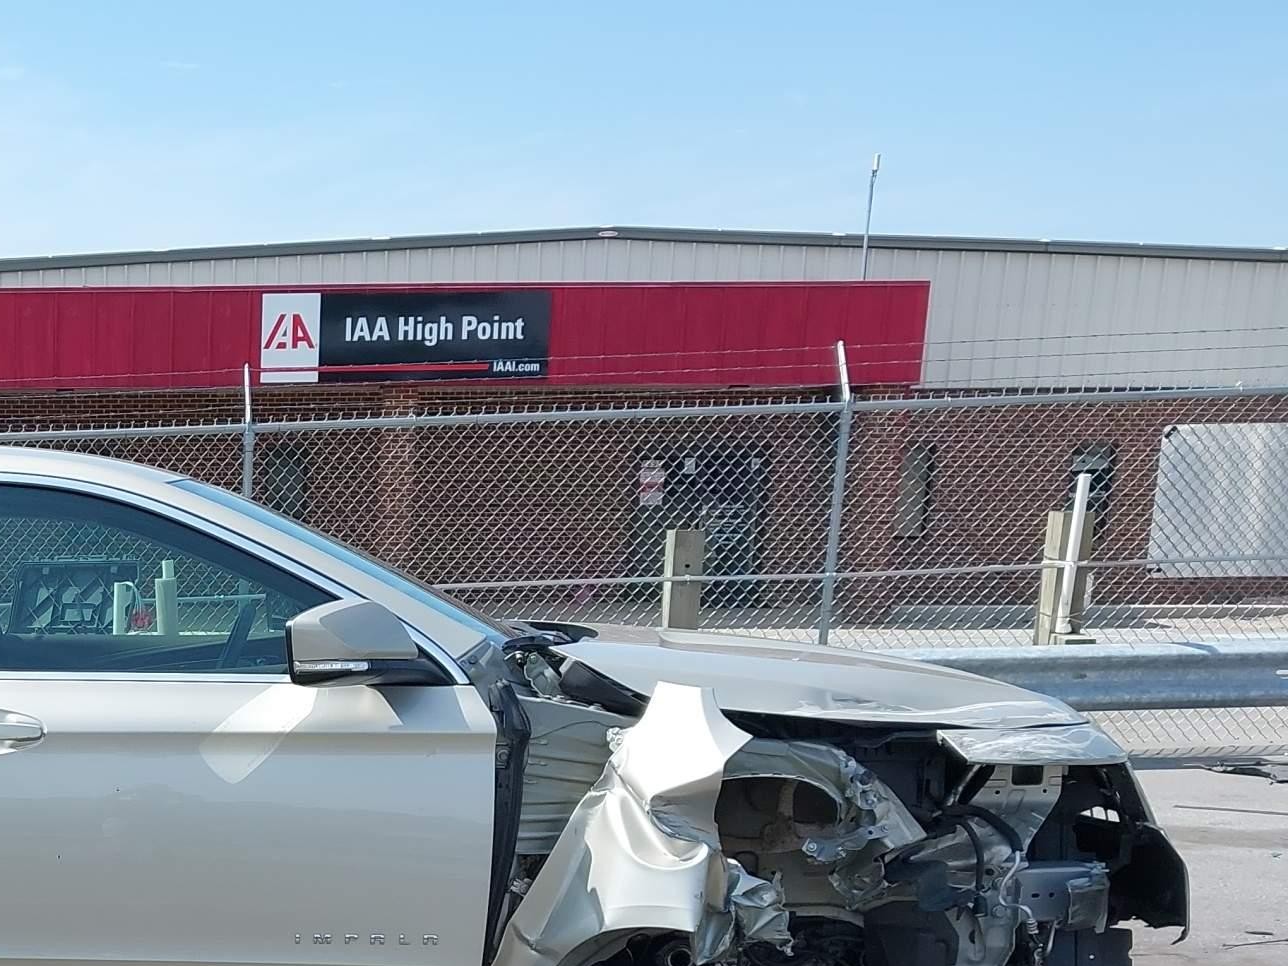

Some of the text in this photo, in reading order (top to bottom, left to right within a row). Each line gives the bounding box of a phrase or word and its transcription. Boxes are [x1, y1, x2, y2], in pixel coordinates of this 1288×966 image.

[345, 315, 525, 347] IAA High Point
[294, 932, 440, 945] IMPALA
